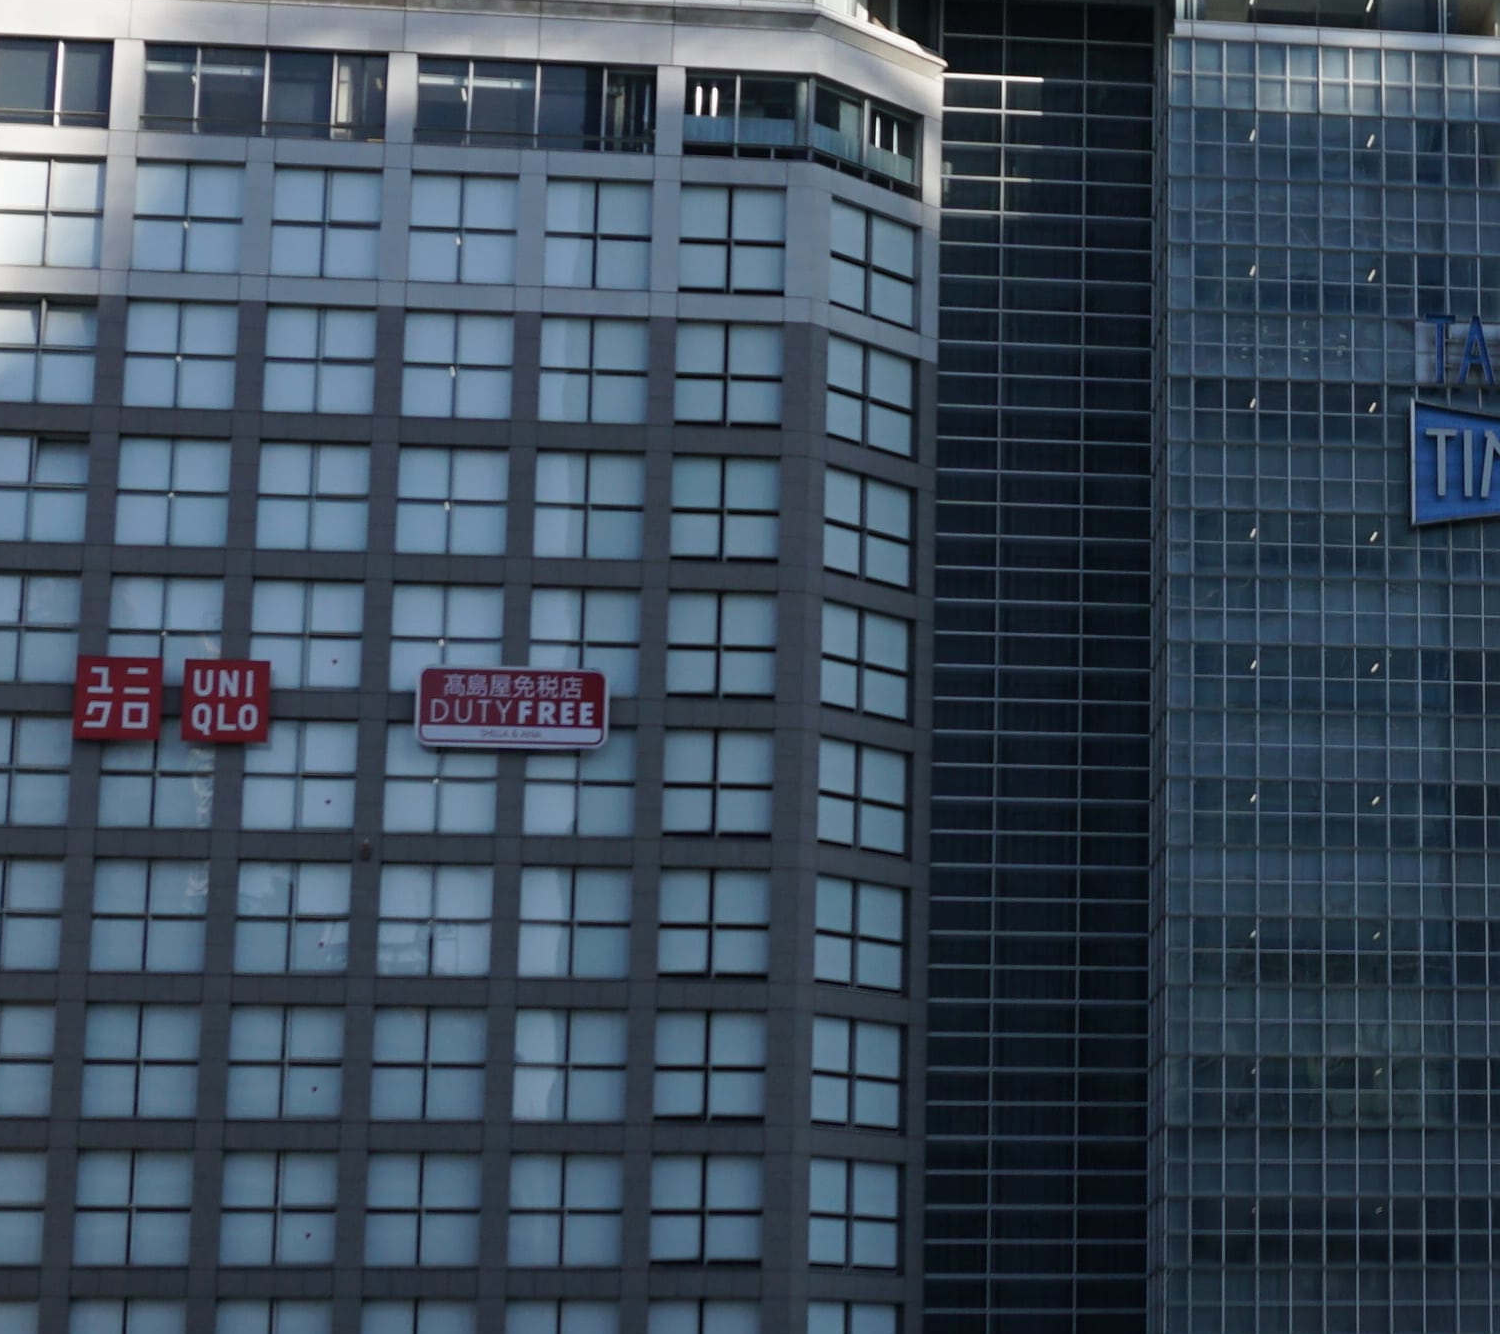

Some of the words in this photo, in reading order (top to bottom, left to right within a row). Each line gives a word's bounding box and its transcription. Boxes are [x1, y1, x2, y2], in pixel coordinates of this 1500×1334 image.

[86, 665, 151, 696] ユニ
[193, 670, 255, 698] UNI
[82, 701, 150, 731] クロ
[190, 703, 260, 735] QLO
